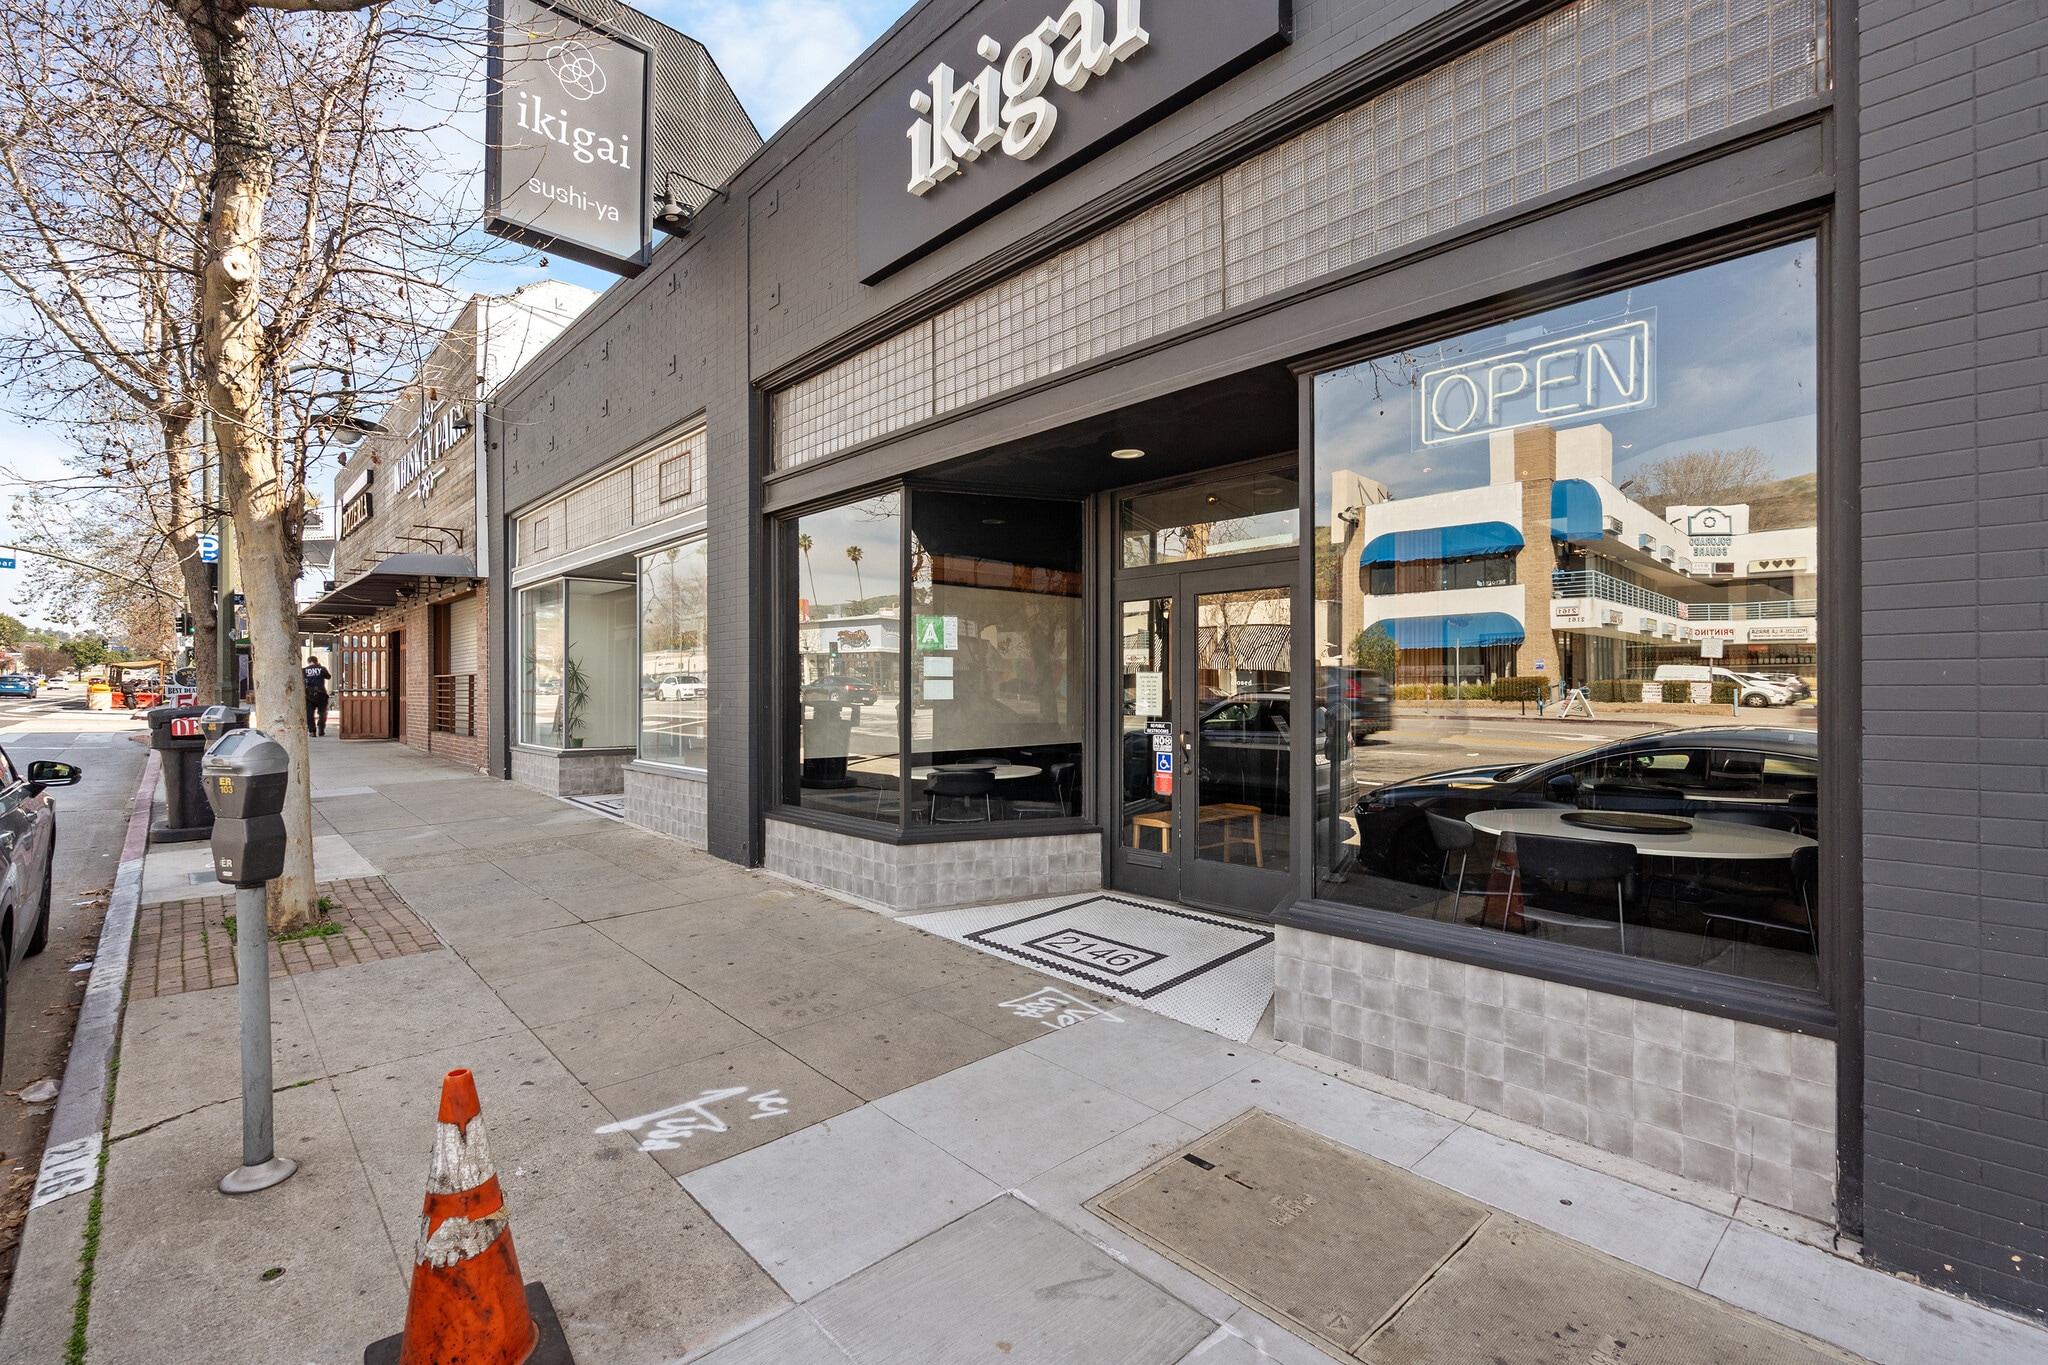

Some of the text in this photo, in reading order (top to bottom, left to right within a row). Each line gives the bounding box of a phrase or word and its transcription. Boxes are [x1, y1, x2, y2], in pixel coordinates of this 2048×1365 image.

[517, 91, 631, 169] ikigai
[528, 176, 619, 222] sushi-ya
[1431, 334, 1636, 432] OPEN
[219, 777, 232, 786] ER
[220, 786, 234, 794] 103
[1045, 936, 1140, 967] 2146
